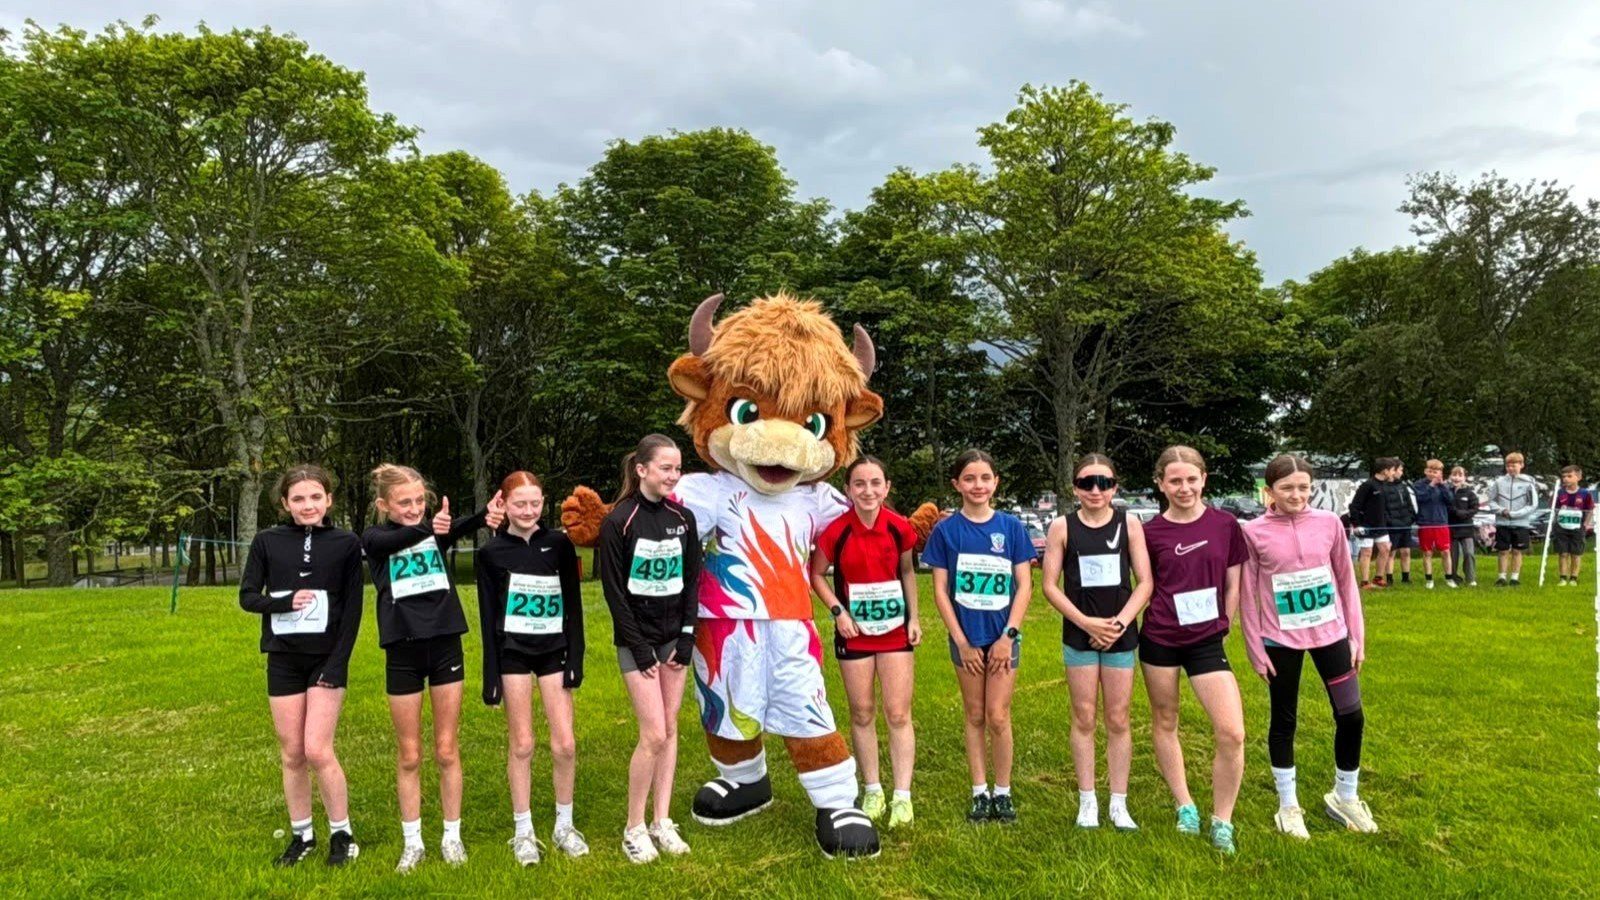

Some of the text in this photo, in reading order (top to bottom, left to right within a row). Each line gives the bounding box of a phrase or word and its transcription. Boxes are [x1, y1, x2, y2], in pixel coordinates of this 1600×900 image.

[392, 550, 443, 579] 234
[635, 557, 679, 580] 492
[960, 571, 1006, 595] 378
[512, 593, 560, 617] 235
[855, 598, 901, 621] 459
[1281, 584, 1331, 614] 105
